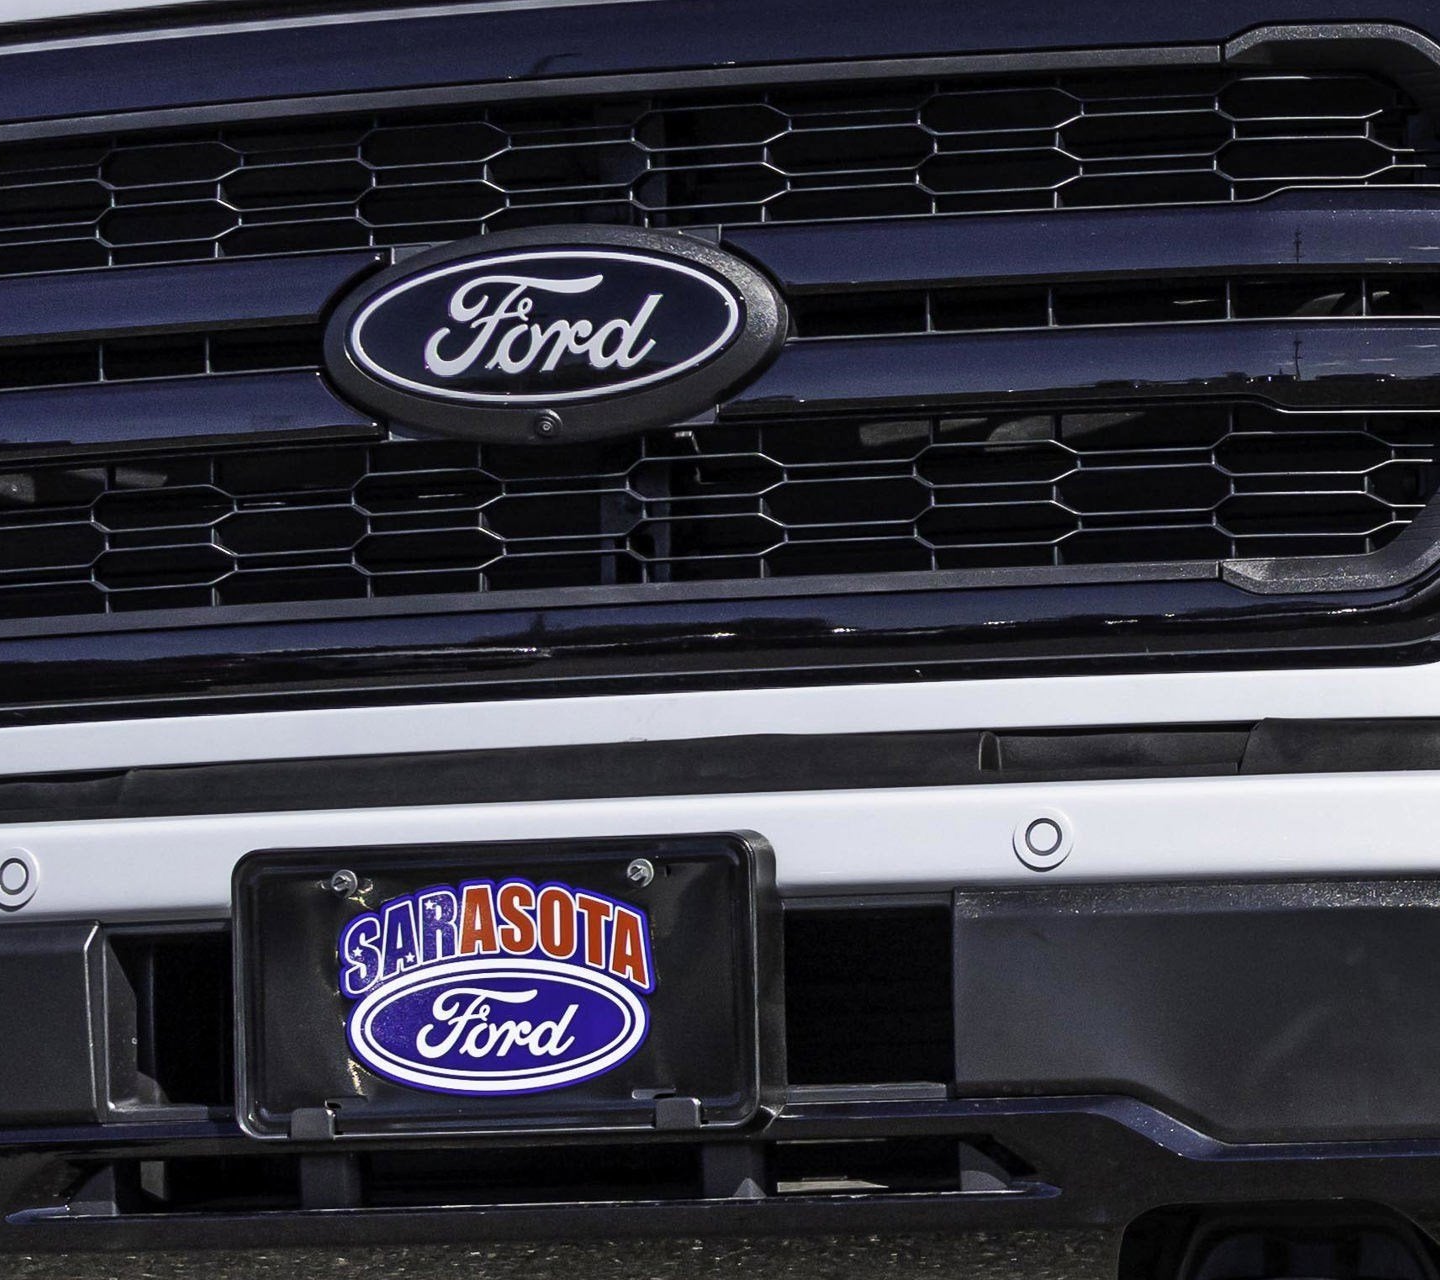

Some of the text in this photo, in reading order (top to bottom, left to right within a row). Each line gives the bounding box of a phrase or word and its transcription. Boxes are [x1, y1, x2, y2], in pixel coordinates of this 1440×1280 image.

[424, 274, 663, 376] Ford
[345, 883, 651, 994] SARASOTA
[415, 987, 578, 1058] Ford
